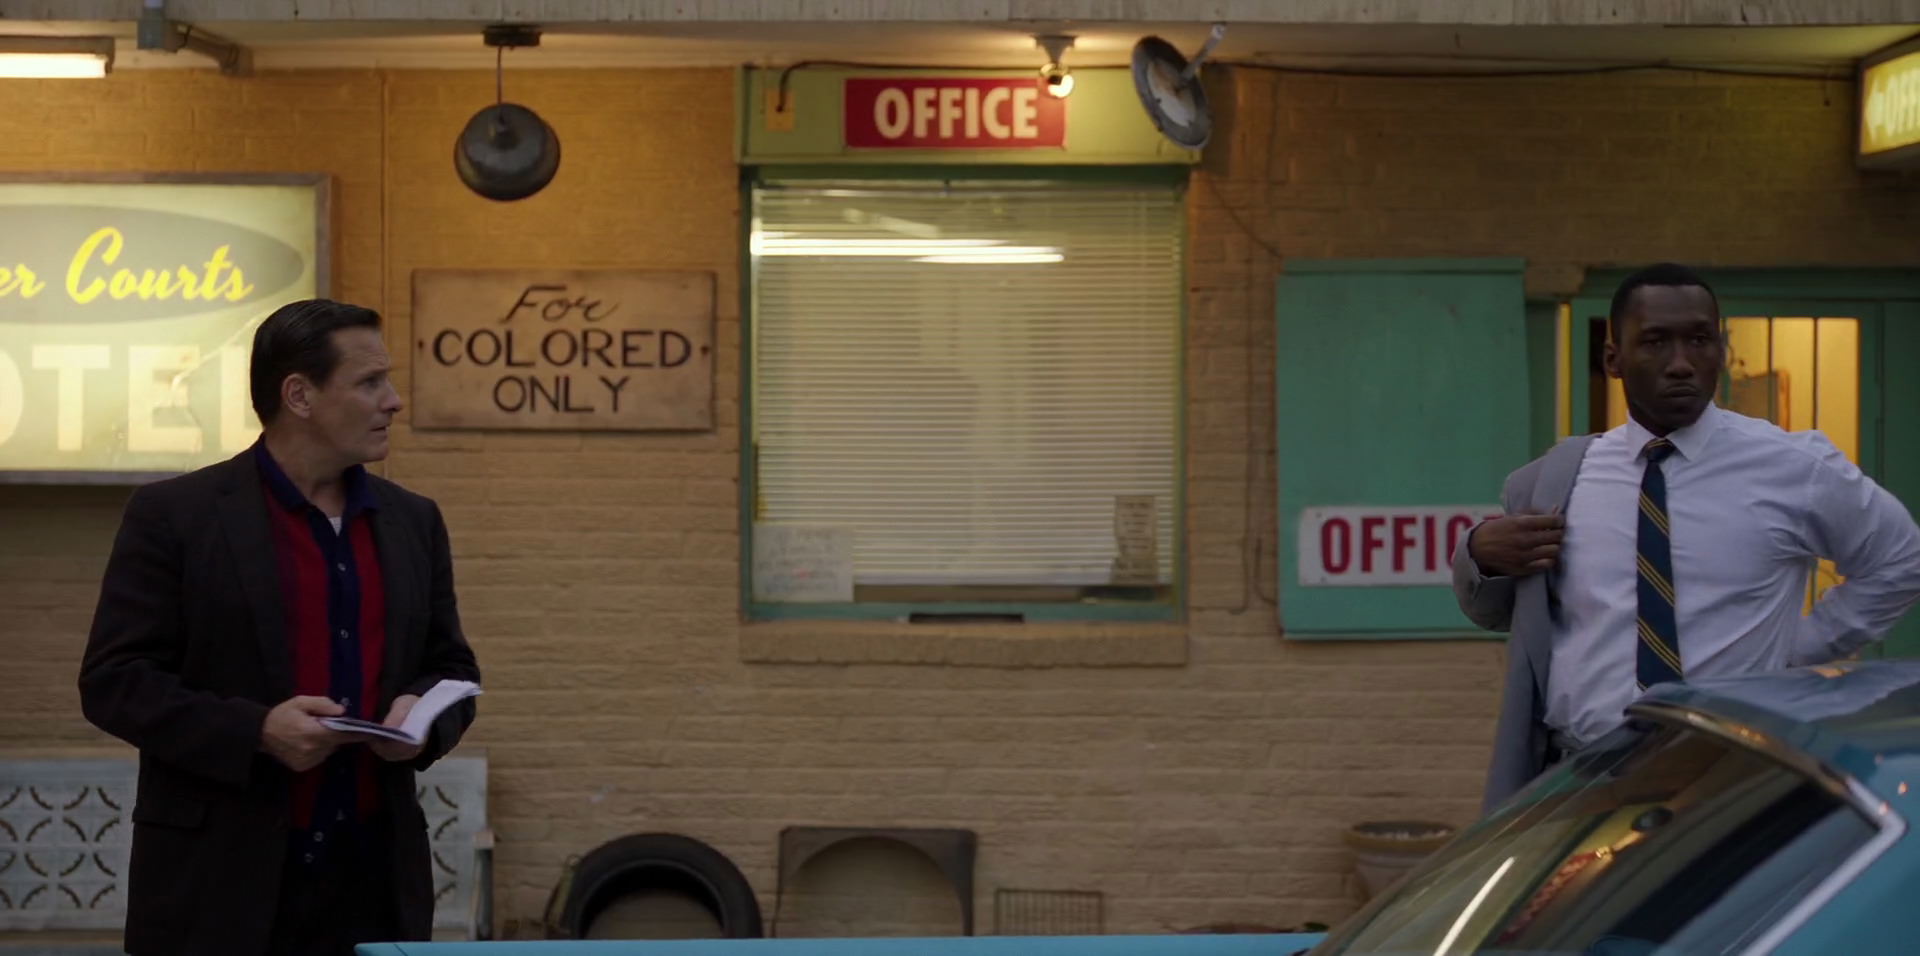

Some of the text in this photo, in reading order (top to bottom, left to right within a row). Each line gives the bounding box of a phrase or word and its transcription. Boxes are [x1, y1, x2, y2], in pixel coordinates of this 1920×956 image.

[873, 87, 1039, 139] OFFICE
[65, 226, 254, 304] Courts
[498, 285, 619, 323] For
[432, 329, 692, 368] COLORED
[493, 375, 630, 413] ONLY
[1321, 514, 1505, 575] OFFIC
